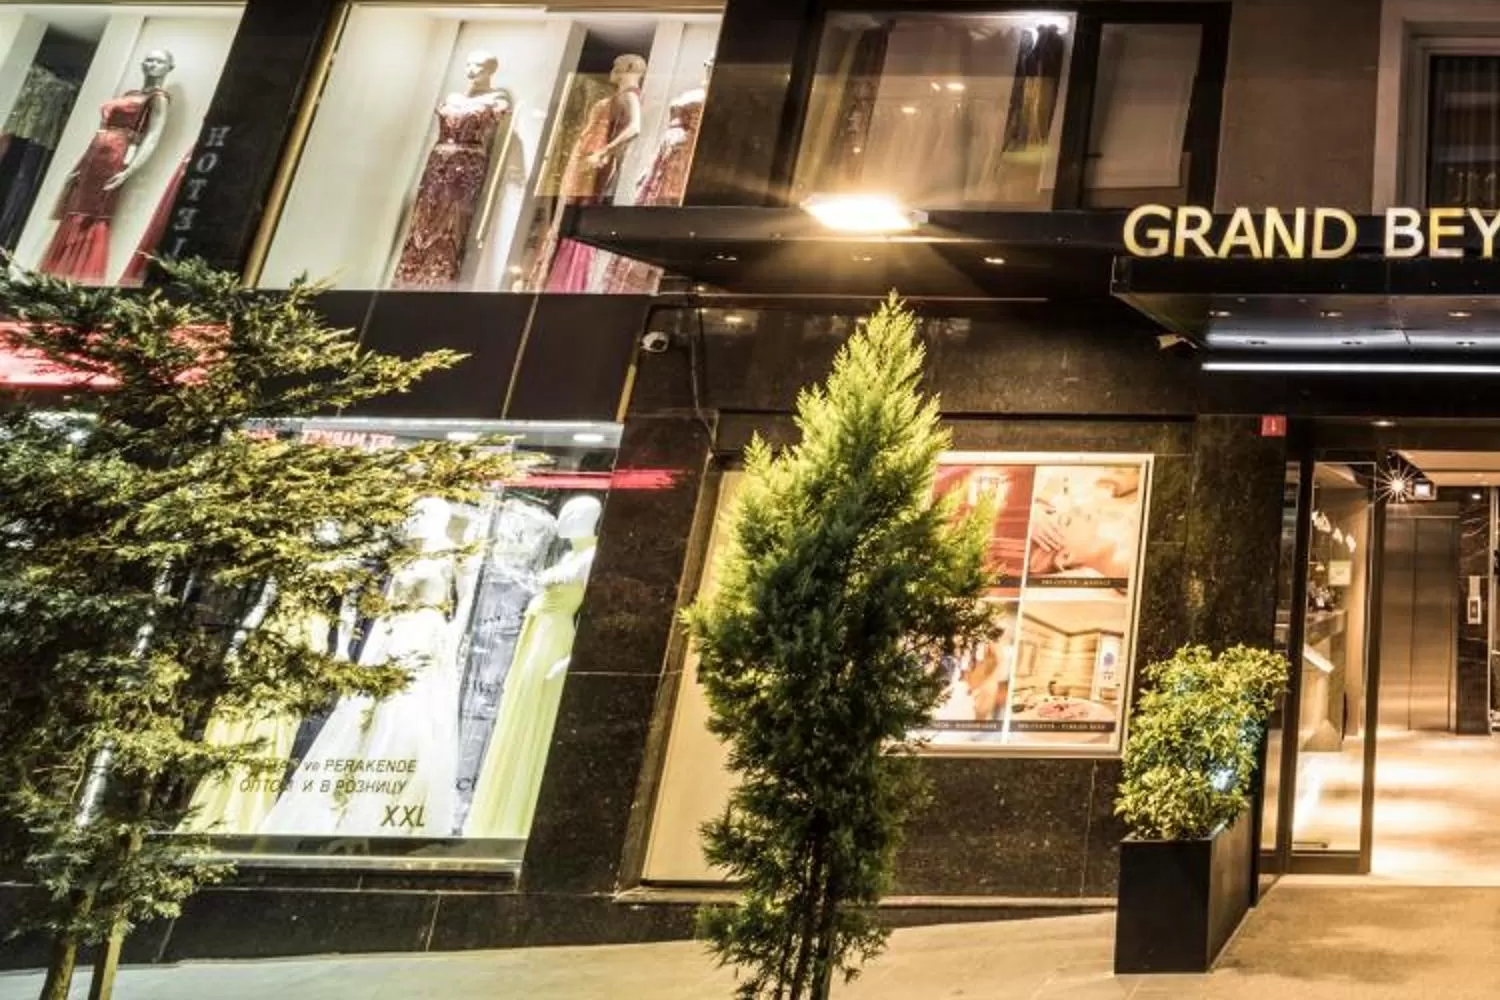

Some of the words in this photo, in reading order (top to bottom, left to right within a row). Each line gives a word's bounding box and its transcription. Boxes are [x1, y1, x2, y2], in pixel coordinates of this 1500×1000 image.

[1123, 204, 1357, 258] GRAND
[324, 758, 417, 773] PERAKENDE
[335, 778, 407, 795] РОЗНИЦУ
[380, 804, 425, 827] XXL
